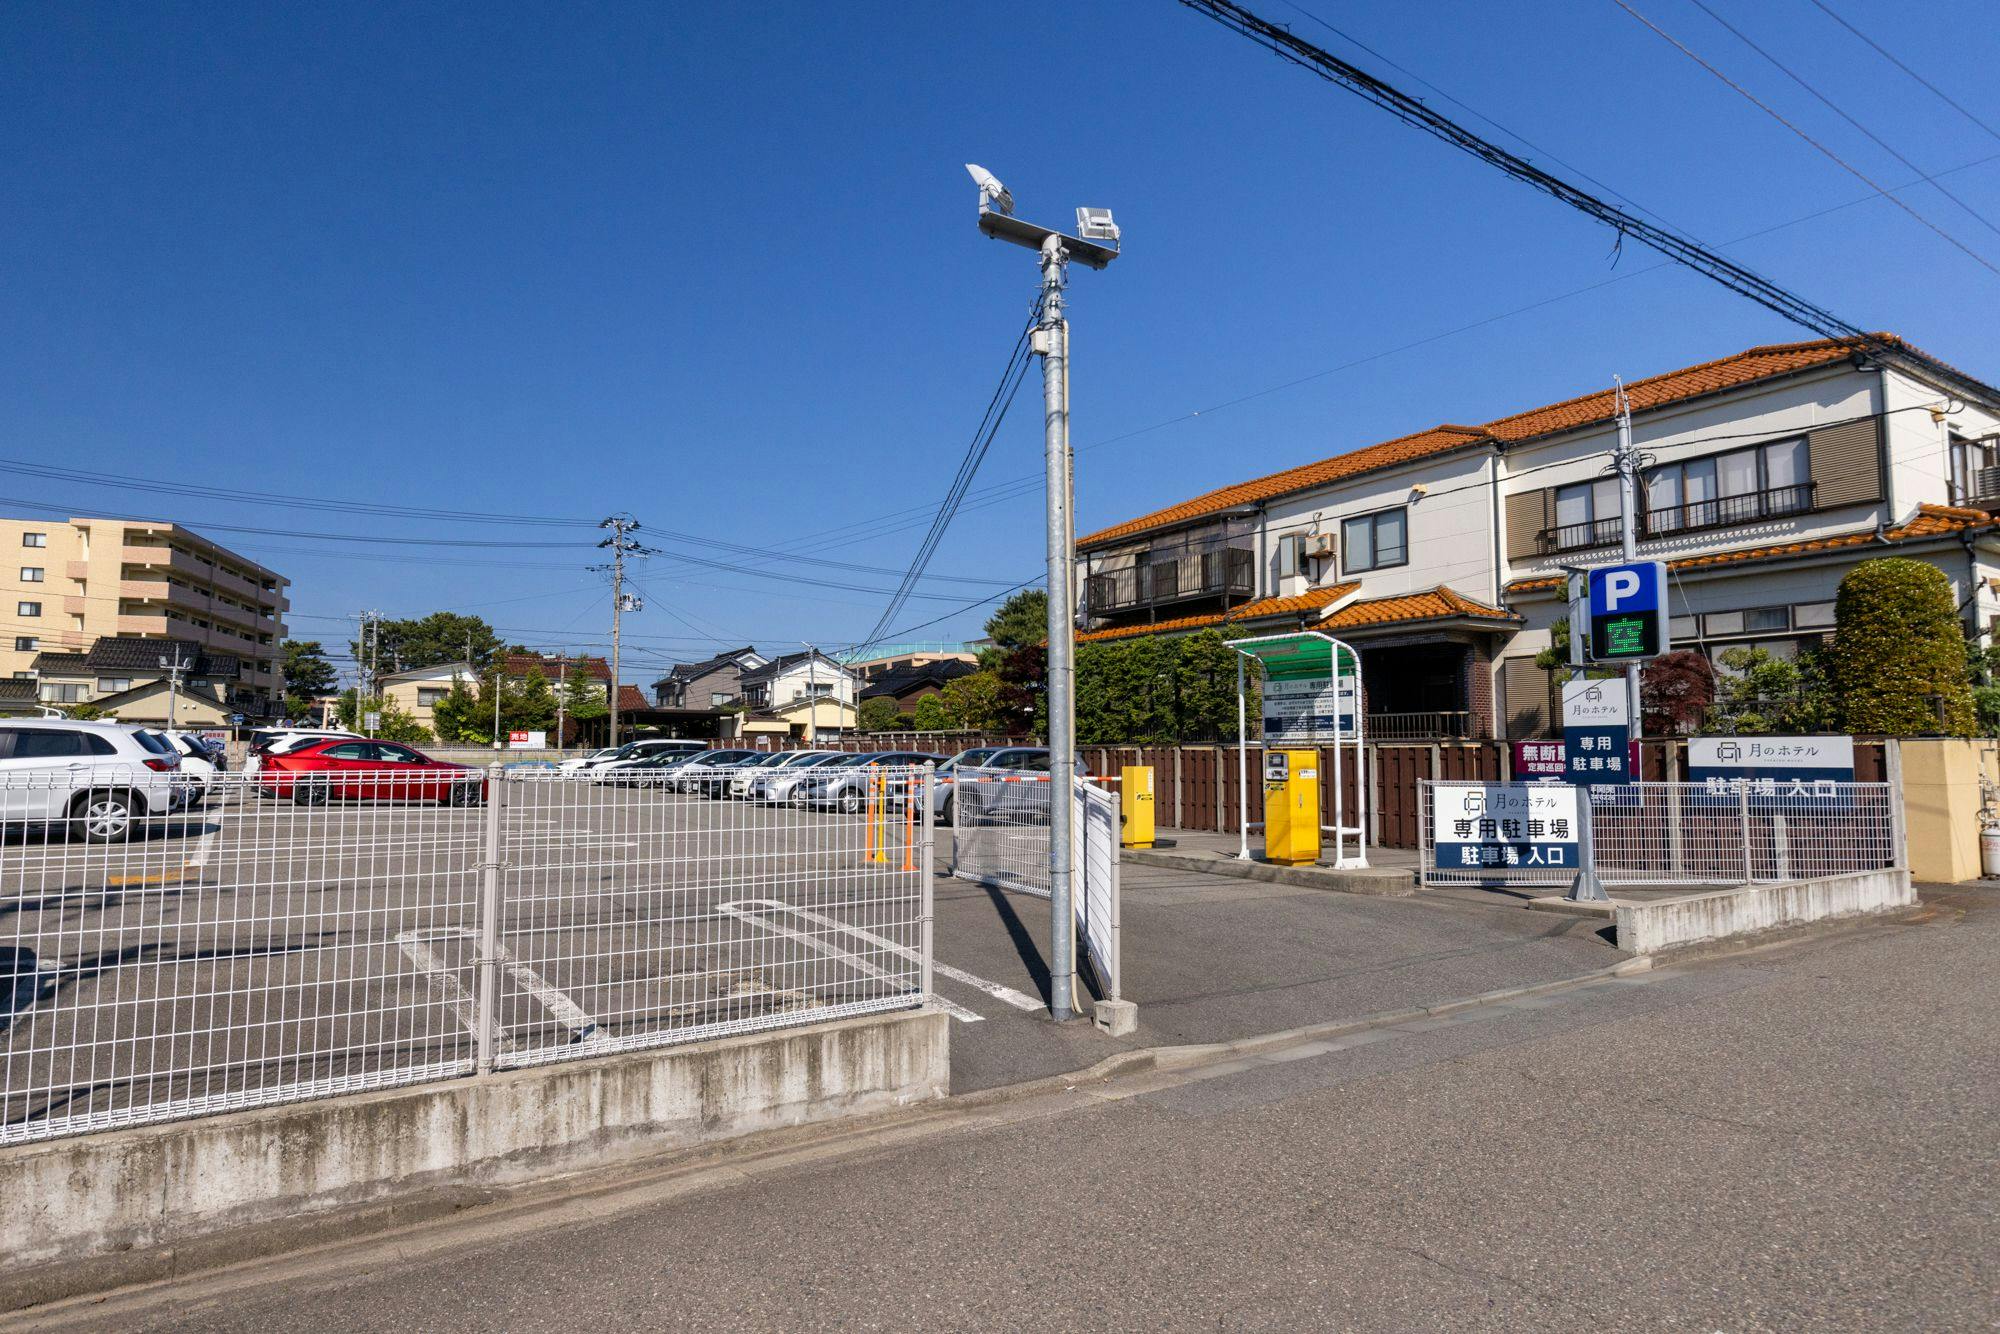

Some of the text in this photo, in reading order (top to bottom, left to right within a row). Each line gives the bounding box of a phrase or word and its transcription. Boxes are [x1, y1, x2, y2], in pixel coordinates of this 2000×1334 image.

[1605, 570, 1641, 612] P
[1607, 617, 1645, 654] 空
[1572, 705, 1618, 716] 月のホテル
[1580, 736, 1612, 751] 専用
[1749, 743, 1819, 758] 月のホテル
[1528, 762, 1567, 773] 定期巡回
[1573, 756, 1622, 772] 駐車場
[1706, 777, 1837, 798] 駐車場 入口
[1495, 793, 1557, 810] 月のホテル
[1453, 818, 1569, 839] 専用駐車場
[1461, 846, 1564, 865] 駐車場 入口
